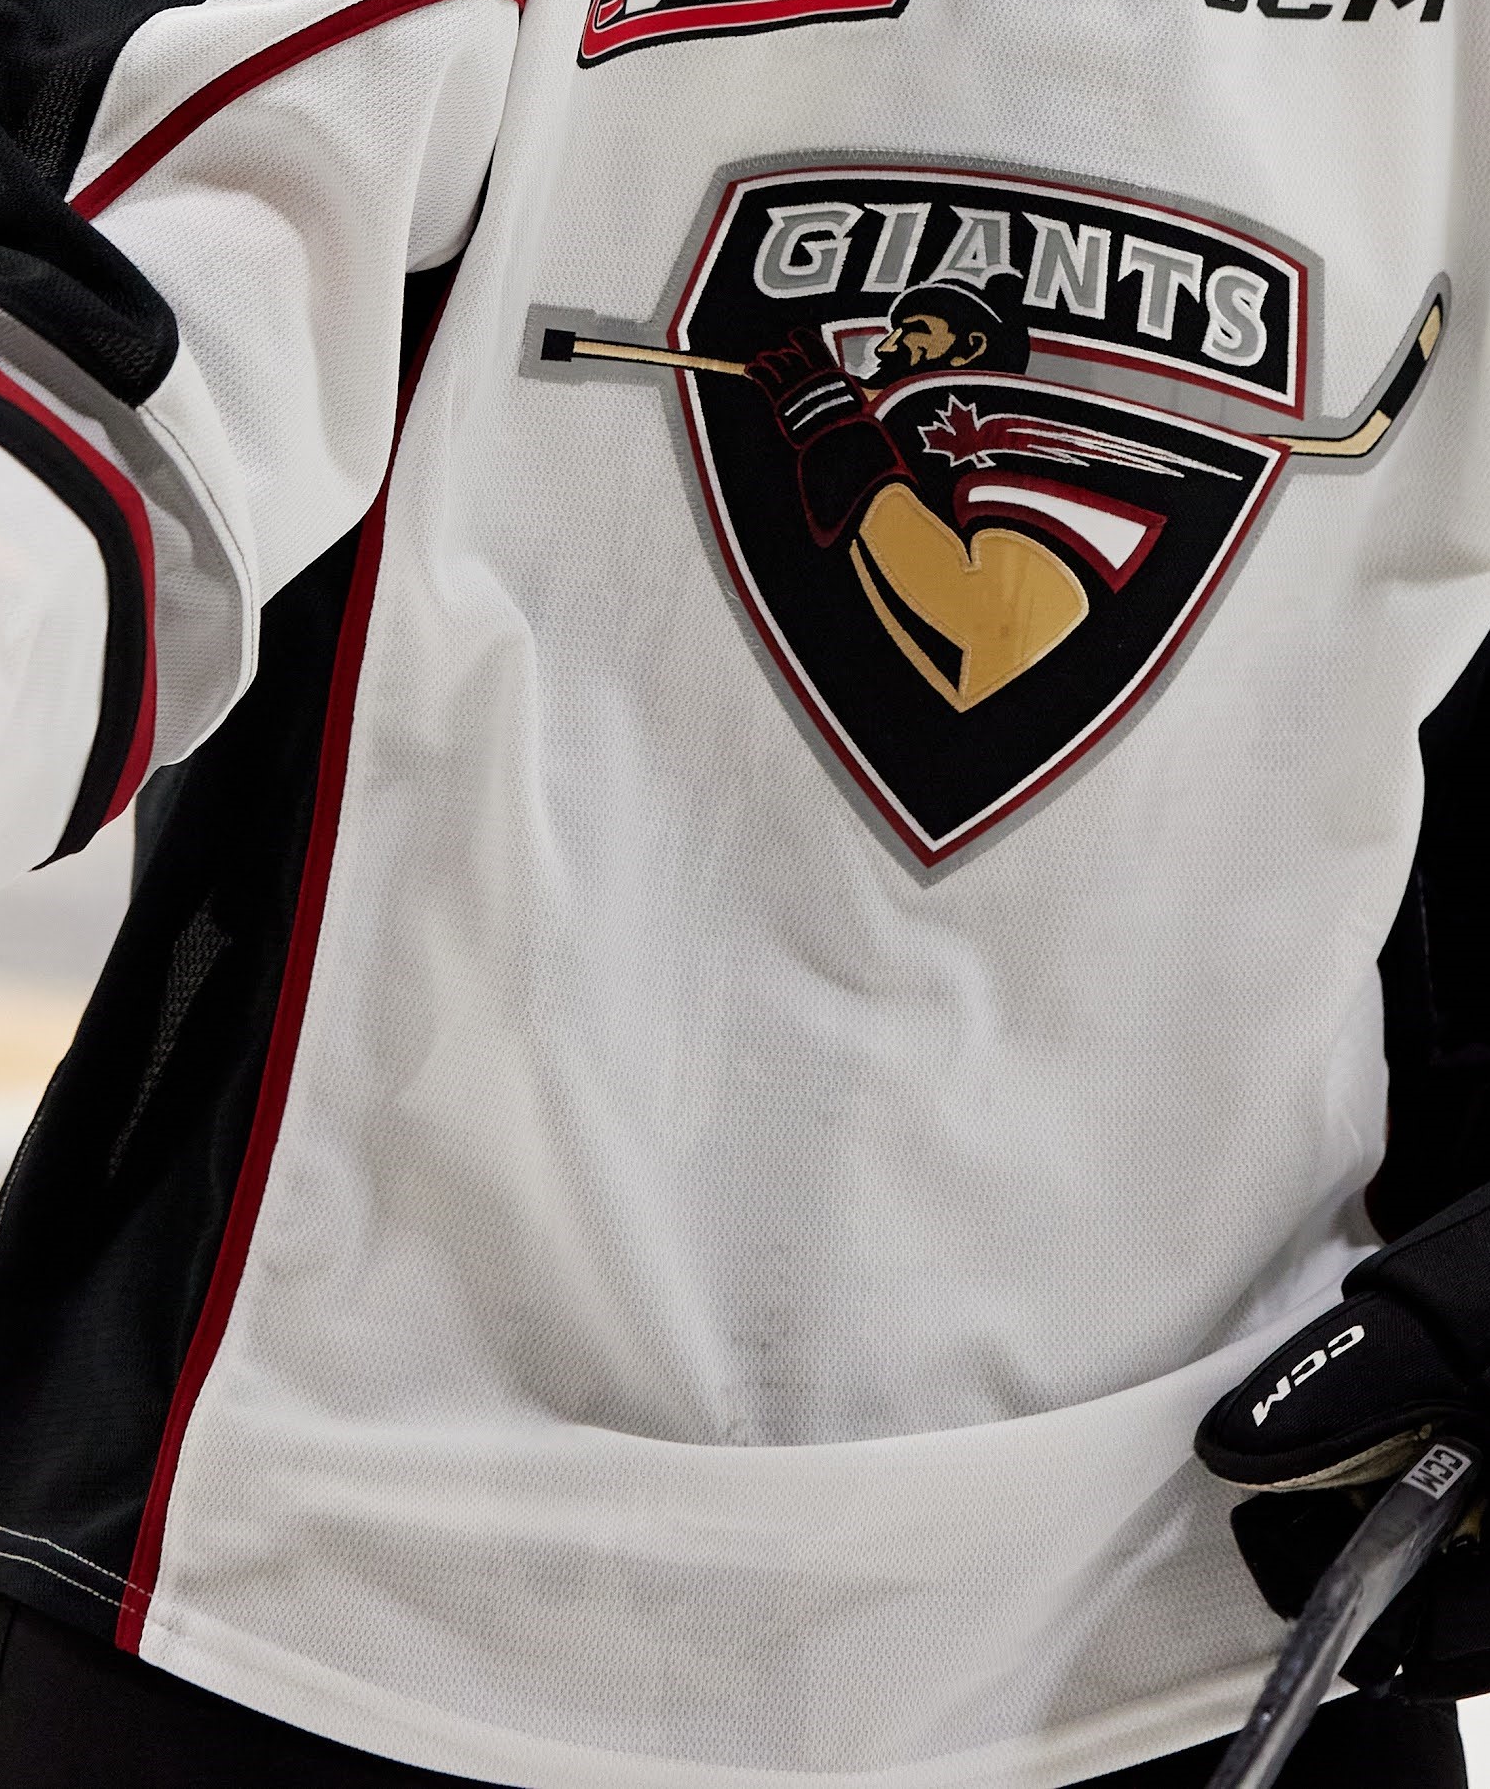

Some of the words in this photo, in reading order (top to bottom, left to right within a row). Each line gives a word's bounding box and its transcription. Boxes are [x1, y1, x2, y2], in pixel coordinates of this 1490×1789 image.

[753, 201, 1269, 367] GIANTS
[1252, 1325, 1365, 1427] CCM
[1411, 1449, 1464, 1493] CCM
